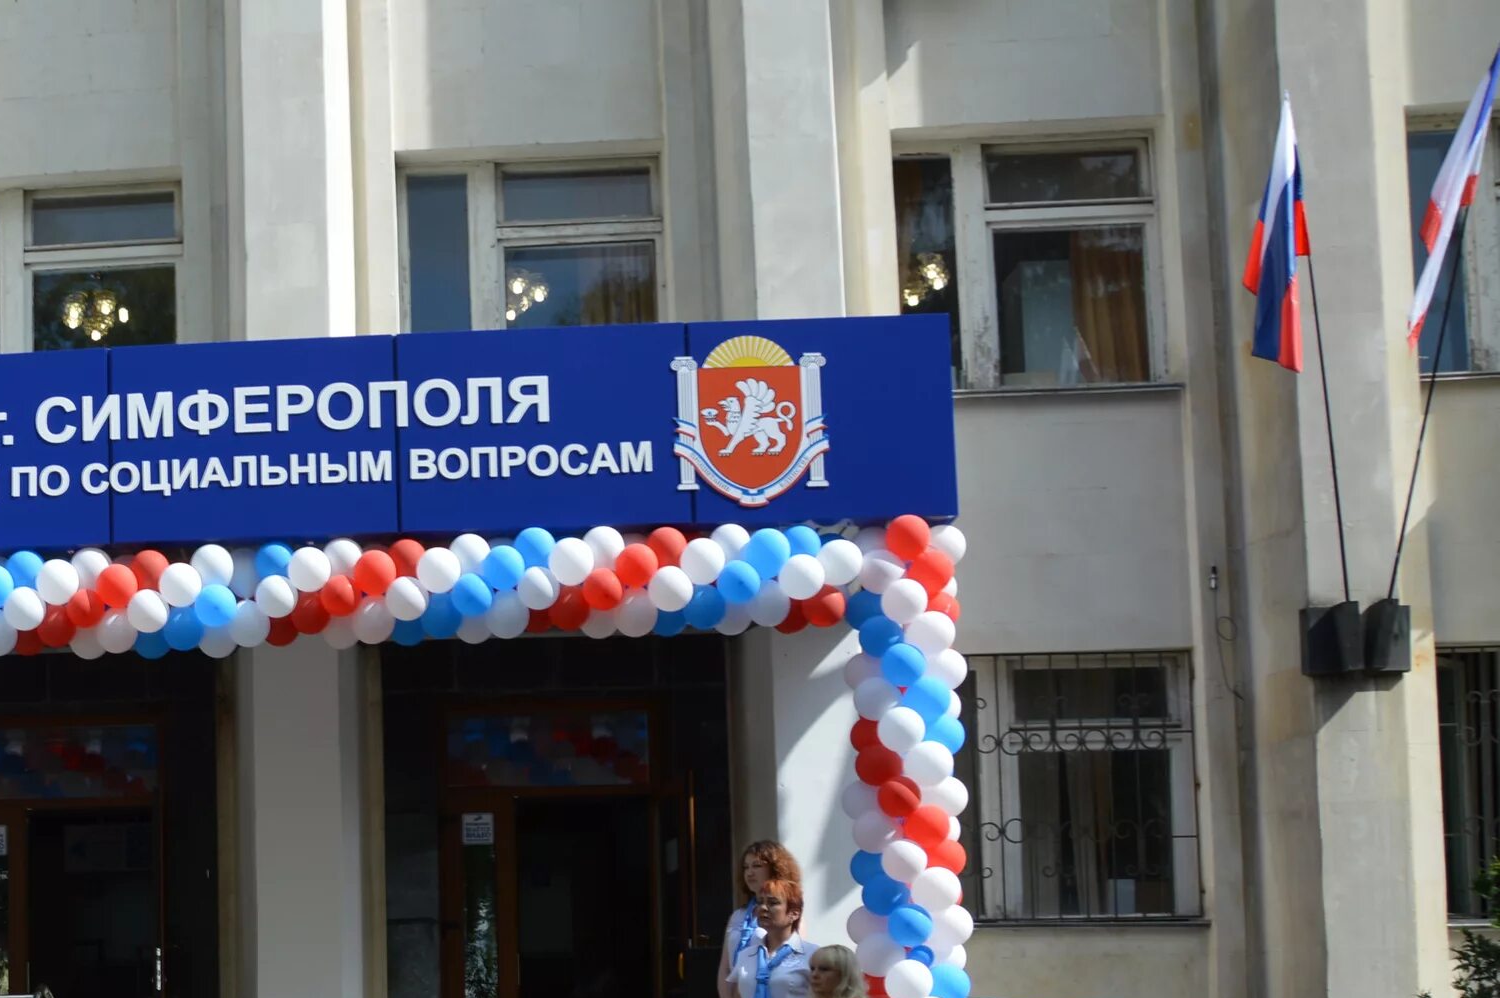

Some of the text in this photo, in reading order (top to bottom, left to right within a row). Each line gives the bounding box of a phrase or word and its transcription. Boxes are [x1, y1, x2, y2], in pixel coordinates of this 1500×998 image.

[36, 376, 550, 443] СИМФЕРОПОЛЯ
[12, 465, 71, 497] ПО
[82, 451, 393, 497] СОЦИАЛЬНЫМ
[410, 441, 653, 480] ВОПРОСАМ
